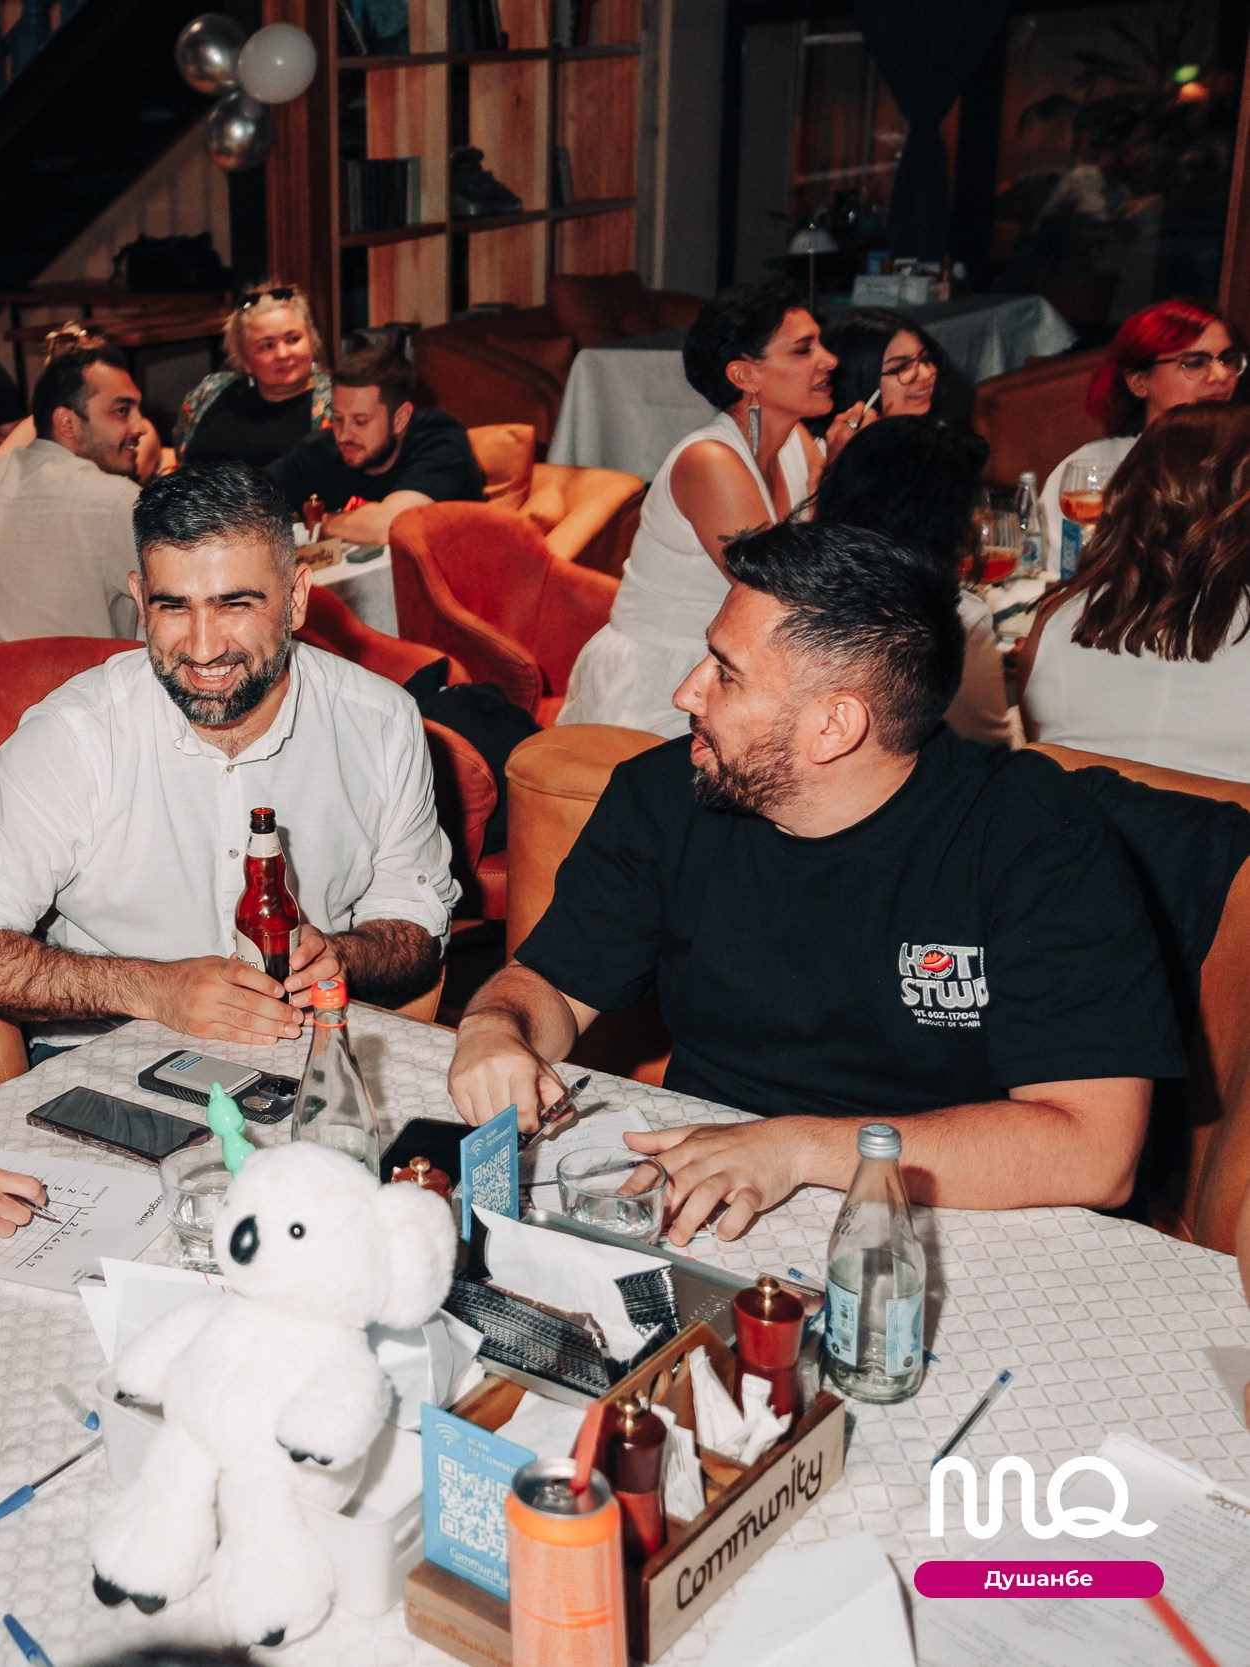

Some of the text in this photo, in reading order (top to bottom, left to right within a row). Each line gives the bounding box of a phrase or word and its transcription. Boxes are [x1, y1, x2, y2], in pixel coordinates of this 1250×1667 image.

[899, 942, 978, 979] HOT
[917, 1018, 945, 1027] PRODUCT
[958, 1020, 981, 1028] SPAIN
[466, 1435, 490, 1453] SCAN
[467, 1446, 480, 1460] TO
[676, 1450, 823, 1610] Community
